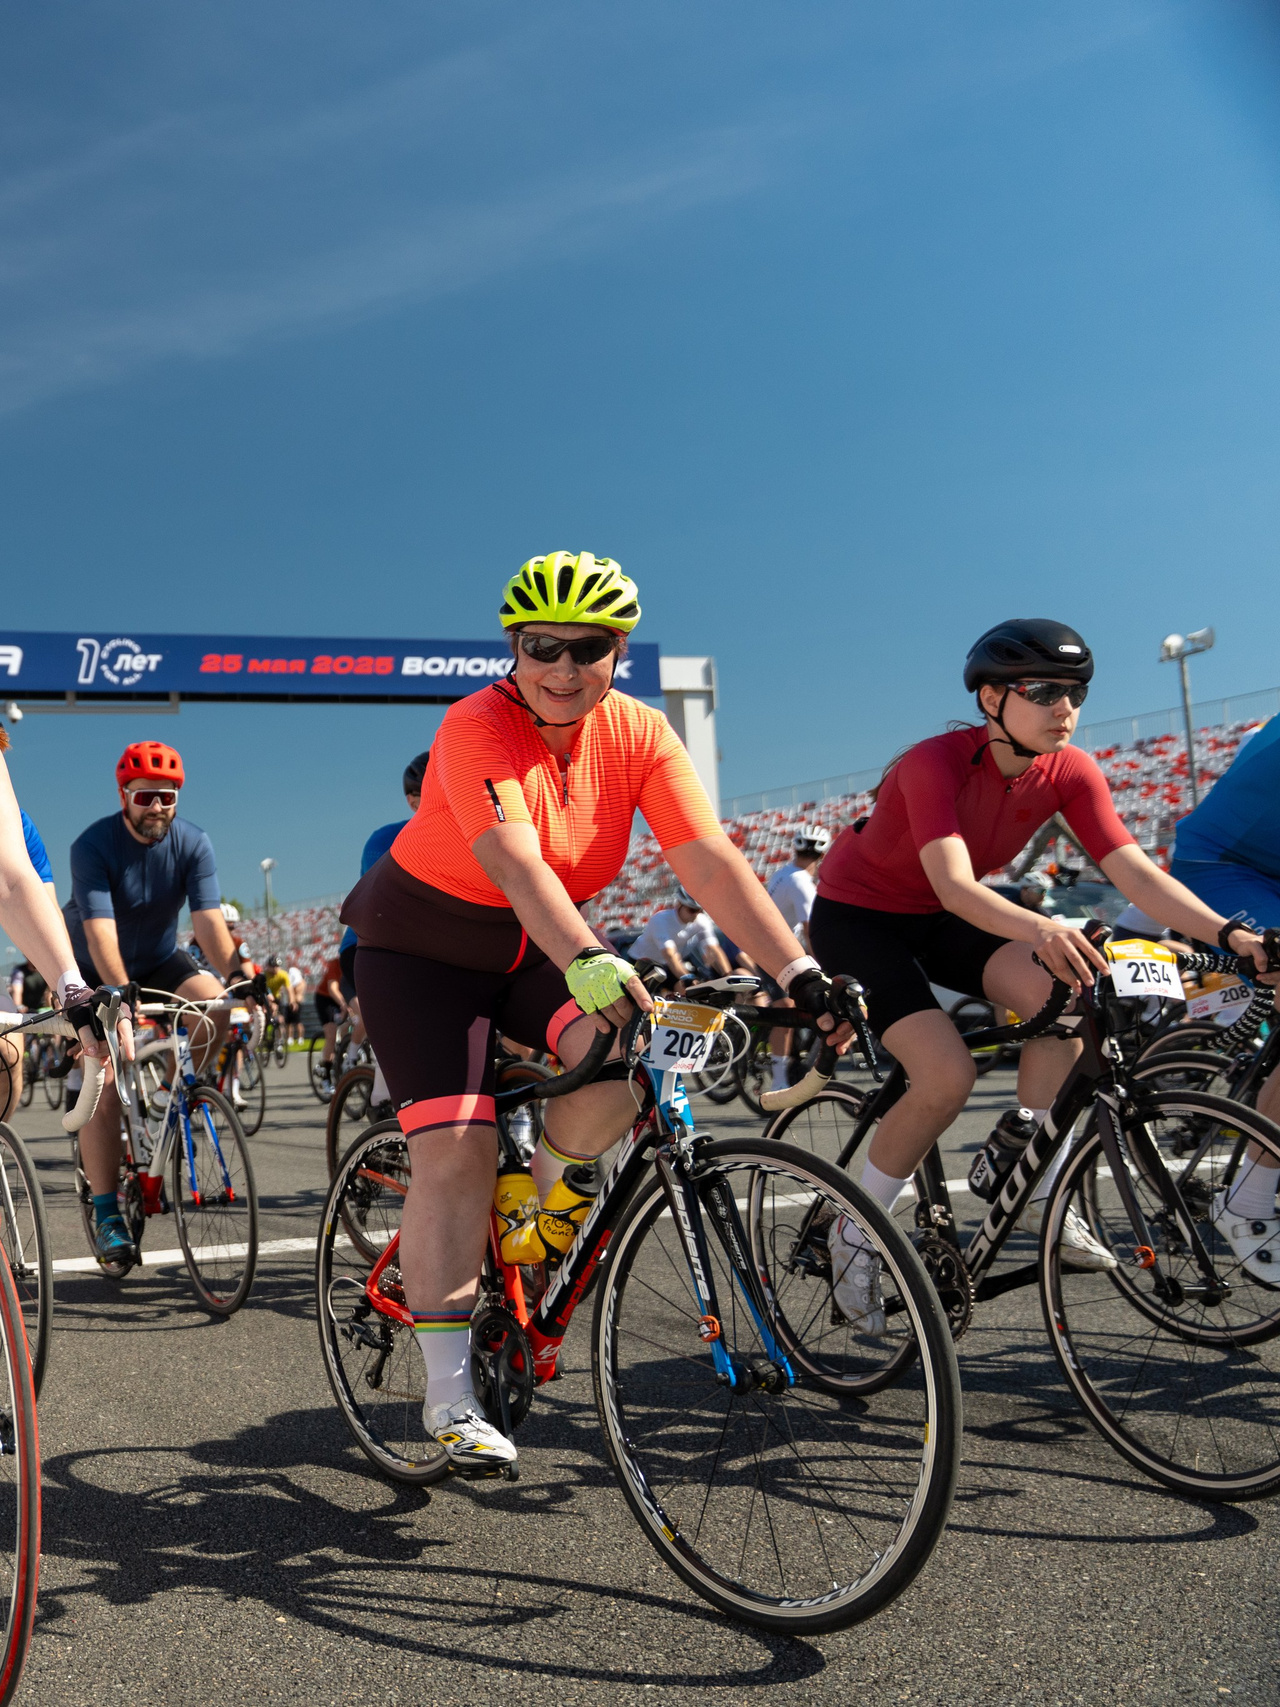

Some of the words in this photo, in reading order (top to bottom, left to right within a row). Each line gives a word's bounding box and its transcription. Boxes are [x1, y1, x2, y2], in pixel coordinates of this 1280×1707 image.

[113, 653, 163, 672] лет
[199, 653, 244, 674] 25
[247, 658, 307, 675] мая
[310, 654, 395, 676] 2025
[1127, 961, 1172, 986] 2154
[1220, 985, 1250, 1003] 208
[861, 1022, 877, 1064] ULTEGRA
[965, 1100, 1061, 1288] SCOTT
[671, 1183, 711, 1301] lapierre
